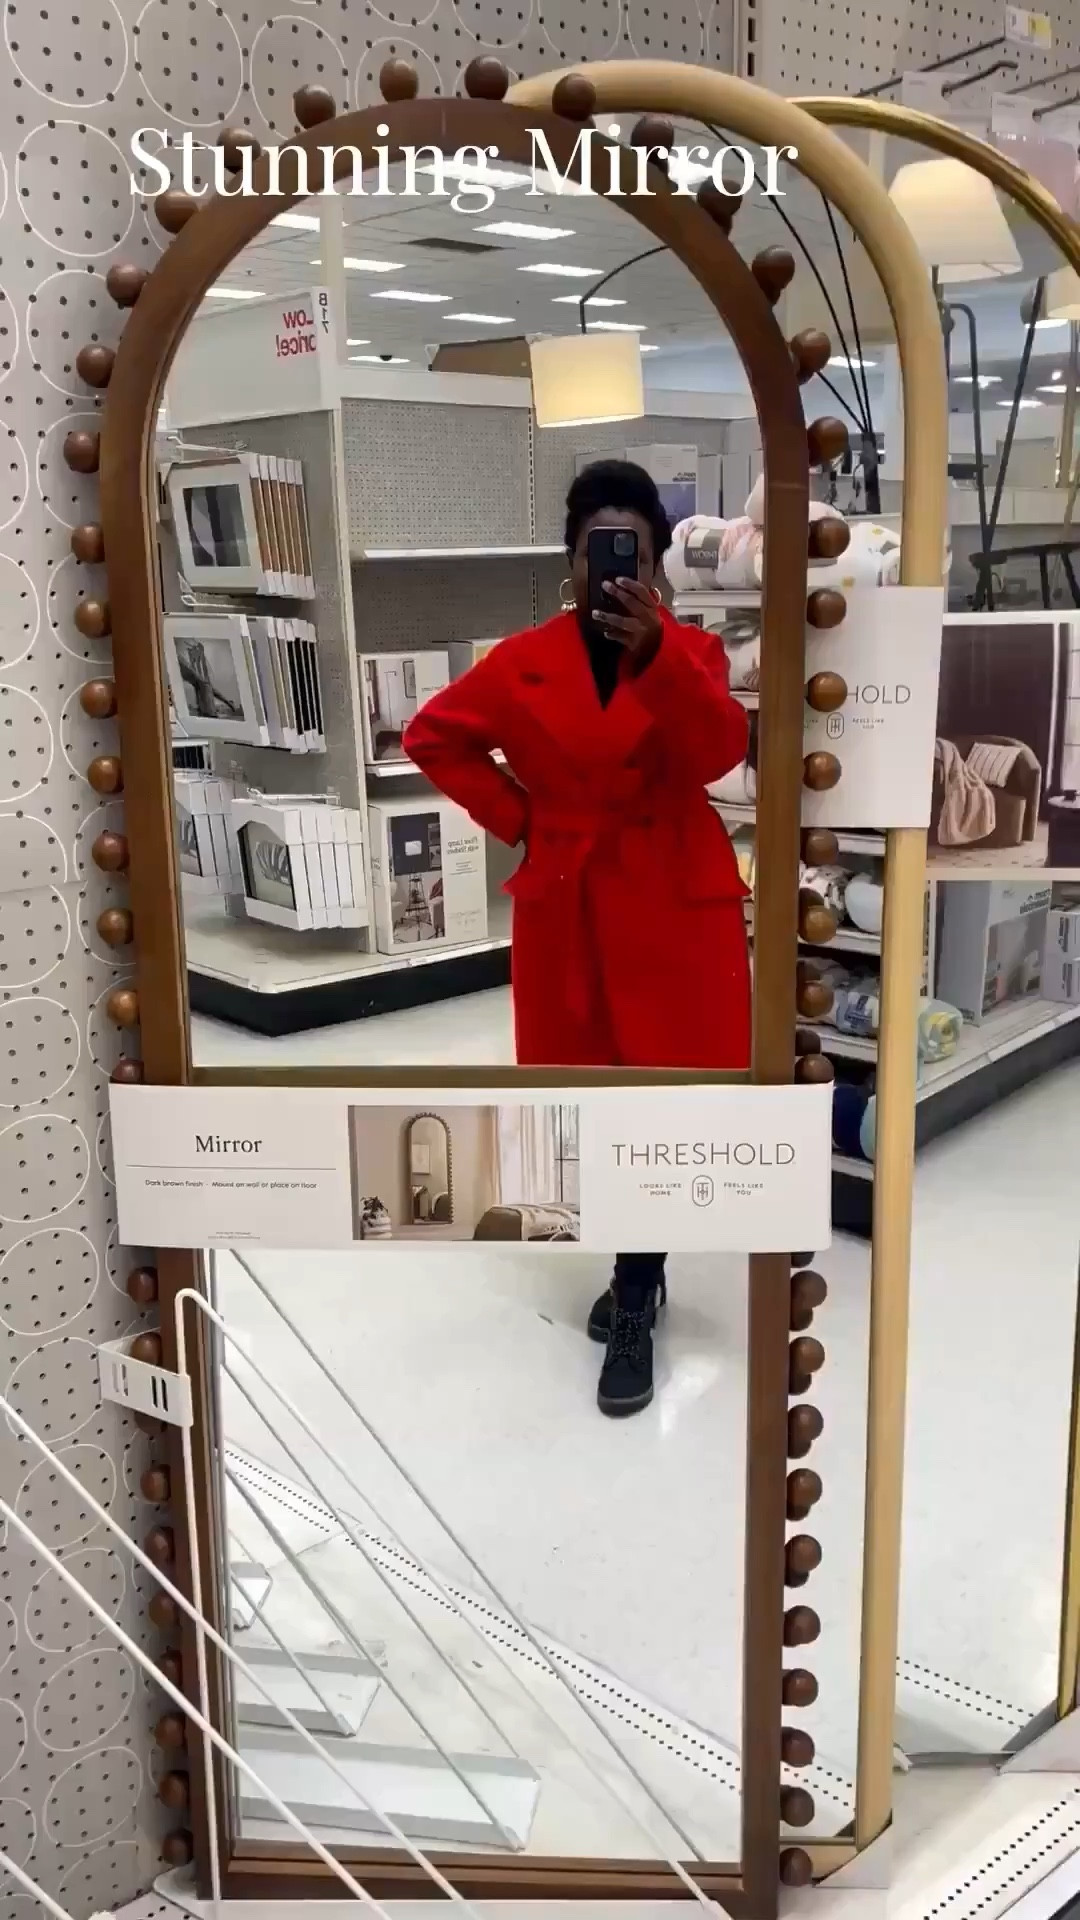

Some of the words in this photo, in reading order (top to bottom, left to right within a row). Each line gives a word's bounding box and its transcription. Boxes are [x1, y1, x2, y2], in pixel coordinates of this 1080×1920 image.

[847, 684, 911, 704] HOLD
[195, 1135, 263, 1153] Mirror
[611, 1142, 796, 1167] THRESHOLD
[270, 1181, 290, 1189] place
